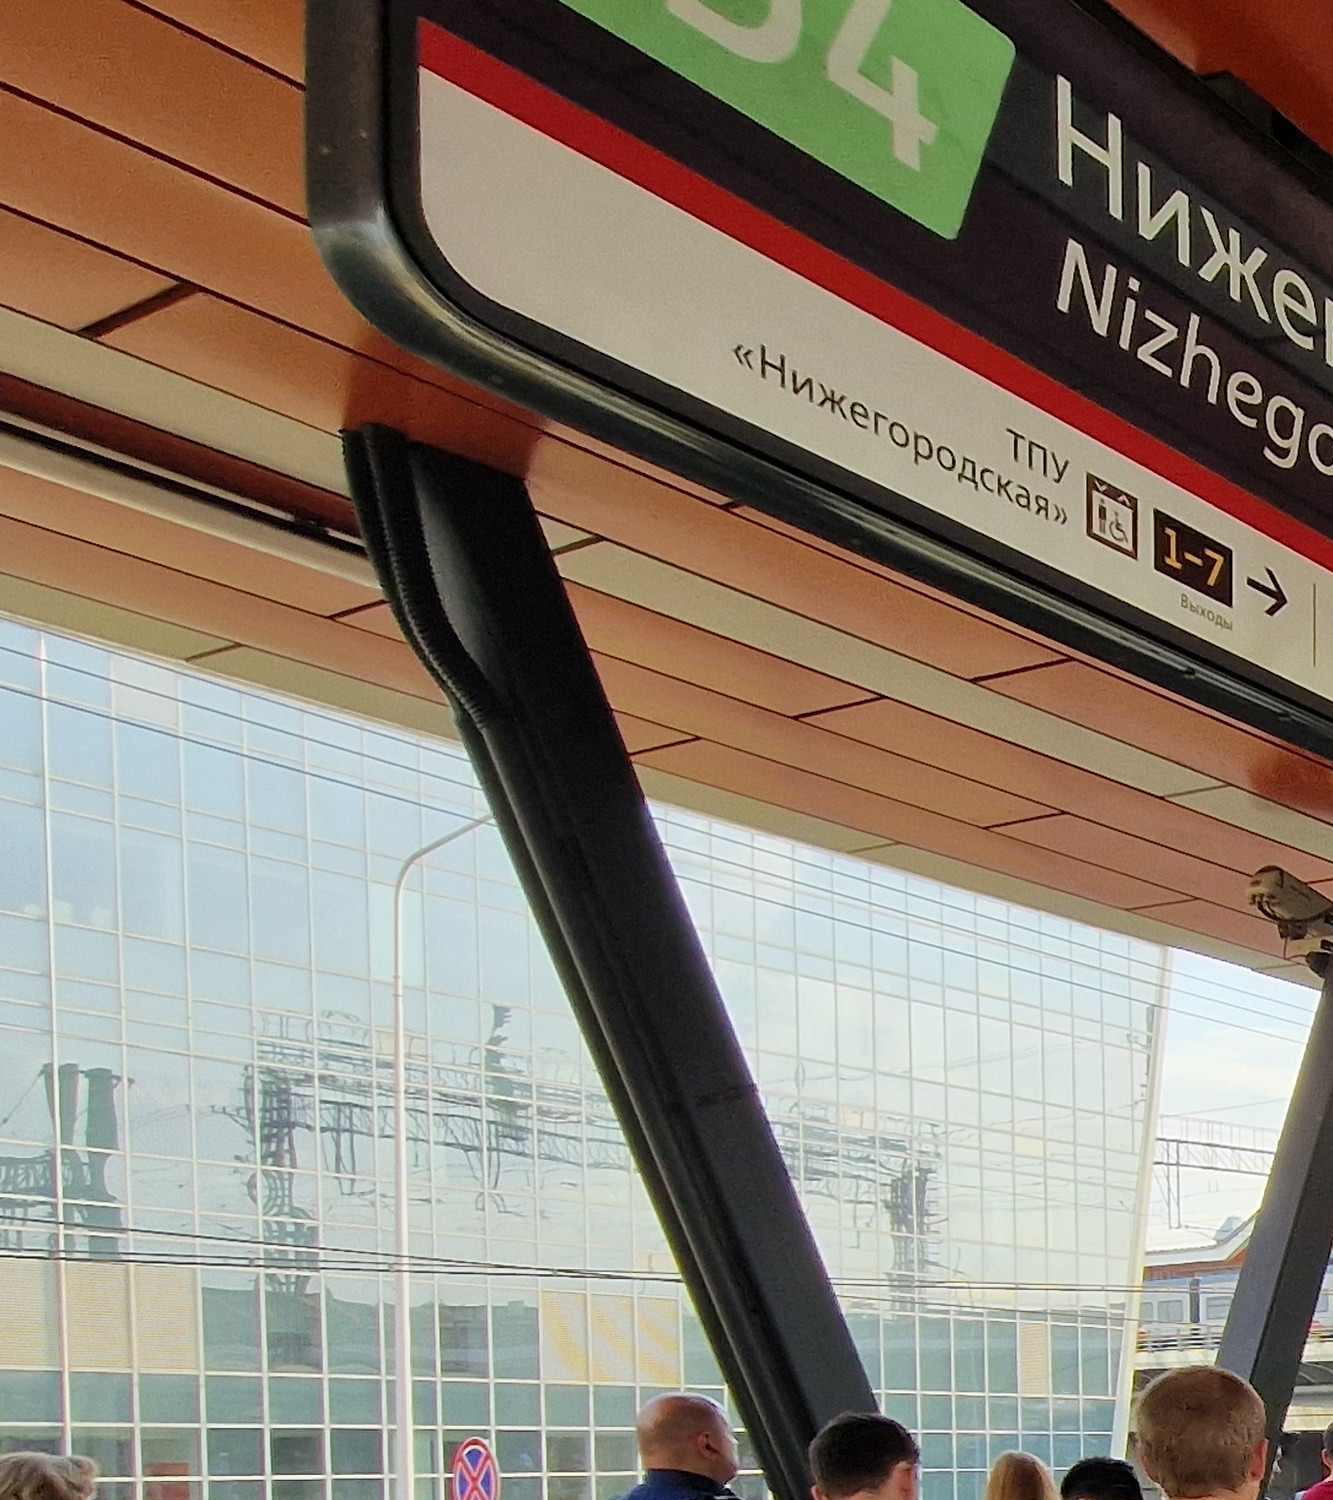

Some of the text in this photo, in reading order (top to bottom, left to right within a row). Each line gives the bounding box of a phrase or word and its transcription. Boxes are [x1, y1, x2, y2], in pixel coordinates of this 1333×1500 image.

[732, 343, 1068, 525] «Нижегородская»
[1006, 427, 1070, 484] ТПУ
[1180, 593, 1233, 632] Выходы
